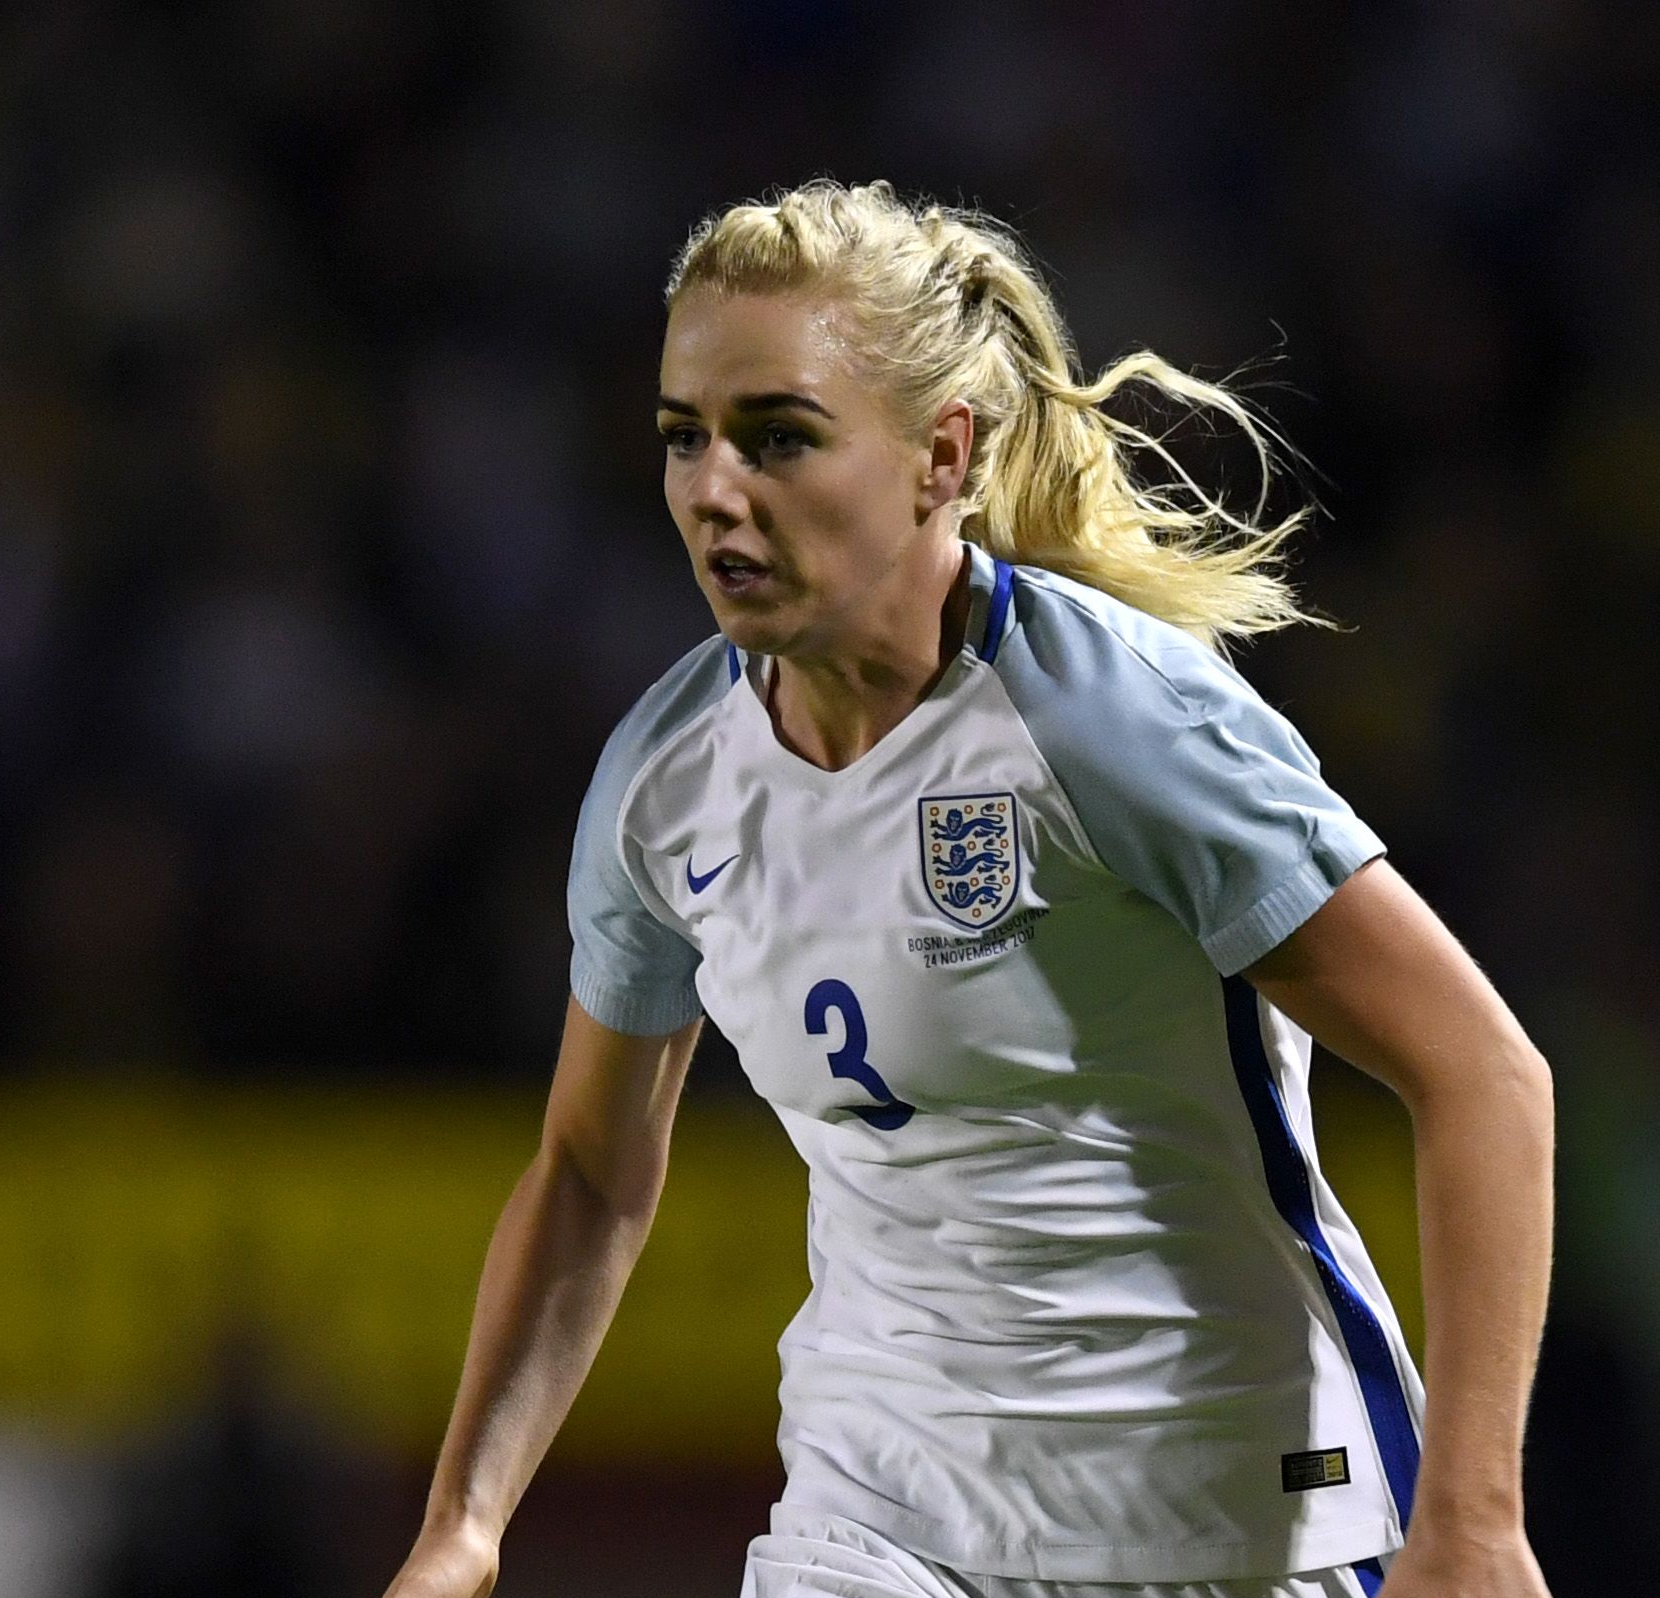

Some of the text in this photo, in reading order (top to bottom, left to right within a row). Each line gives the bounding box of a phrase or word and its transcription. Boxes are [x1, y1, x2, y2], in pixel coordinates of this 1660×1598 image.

[907, 936, 950, 952] BOSNIA
[924, 926, 1035, 968] 24 NOVEMBER 2017
[804, 978, 916, 1131] 3
